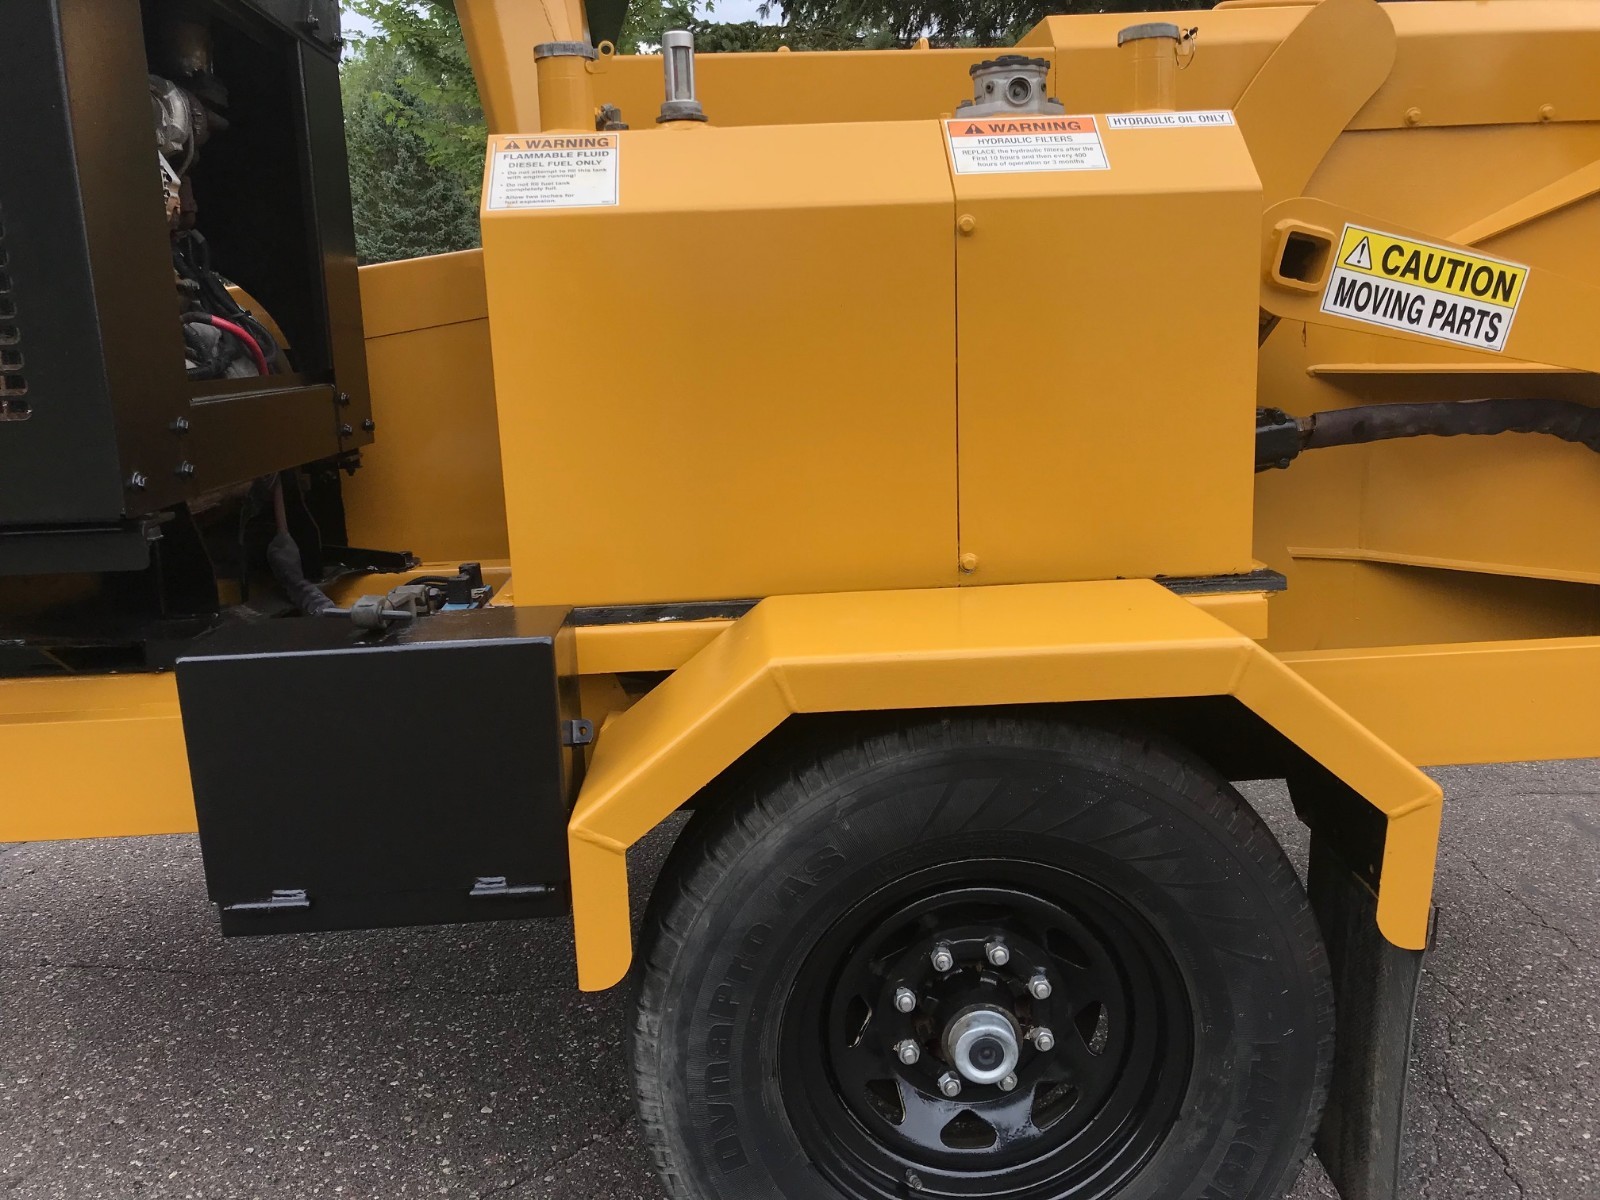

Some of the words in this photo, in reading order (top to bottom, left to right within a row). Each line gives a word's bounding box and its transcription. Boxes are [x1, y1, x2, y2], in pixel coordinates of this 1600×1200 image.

[1113, 116, 1175, 125] HYDRAULIC
[1178, 115, 1196, 124] OIL
[1198, 114, 1225, 123] ONLY
[988, 121, 1082, 133] WARNING
[526, 137, 609, 149] WARNING
[977, 136, 1033, 145] HYDRAULIC
[1036, 135, 1074, 143] FILTERS
[503, 151, 574, 160] FLAMMABLE
[1382, 244, 1518, 303] CAUTION
[1333, 276, 1426, 326] MOVING
[1427, 299, 1503, 343] PARTS
